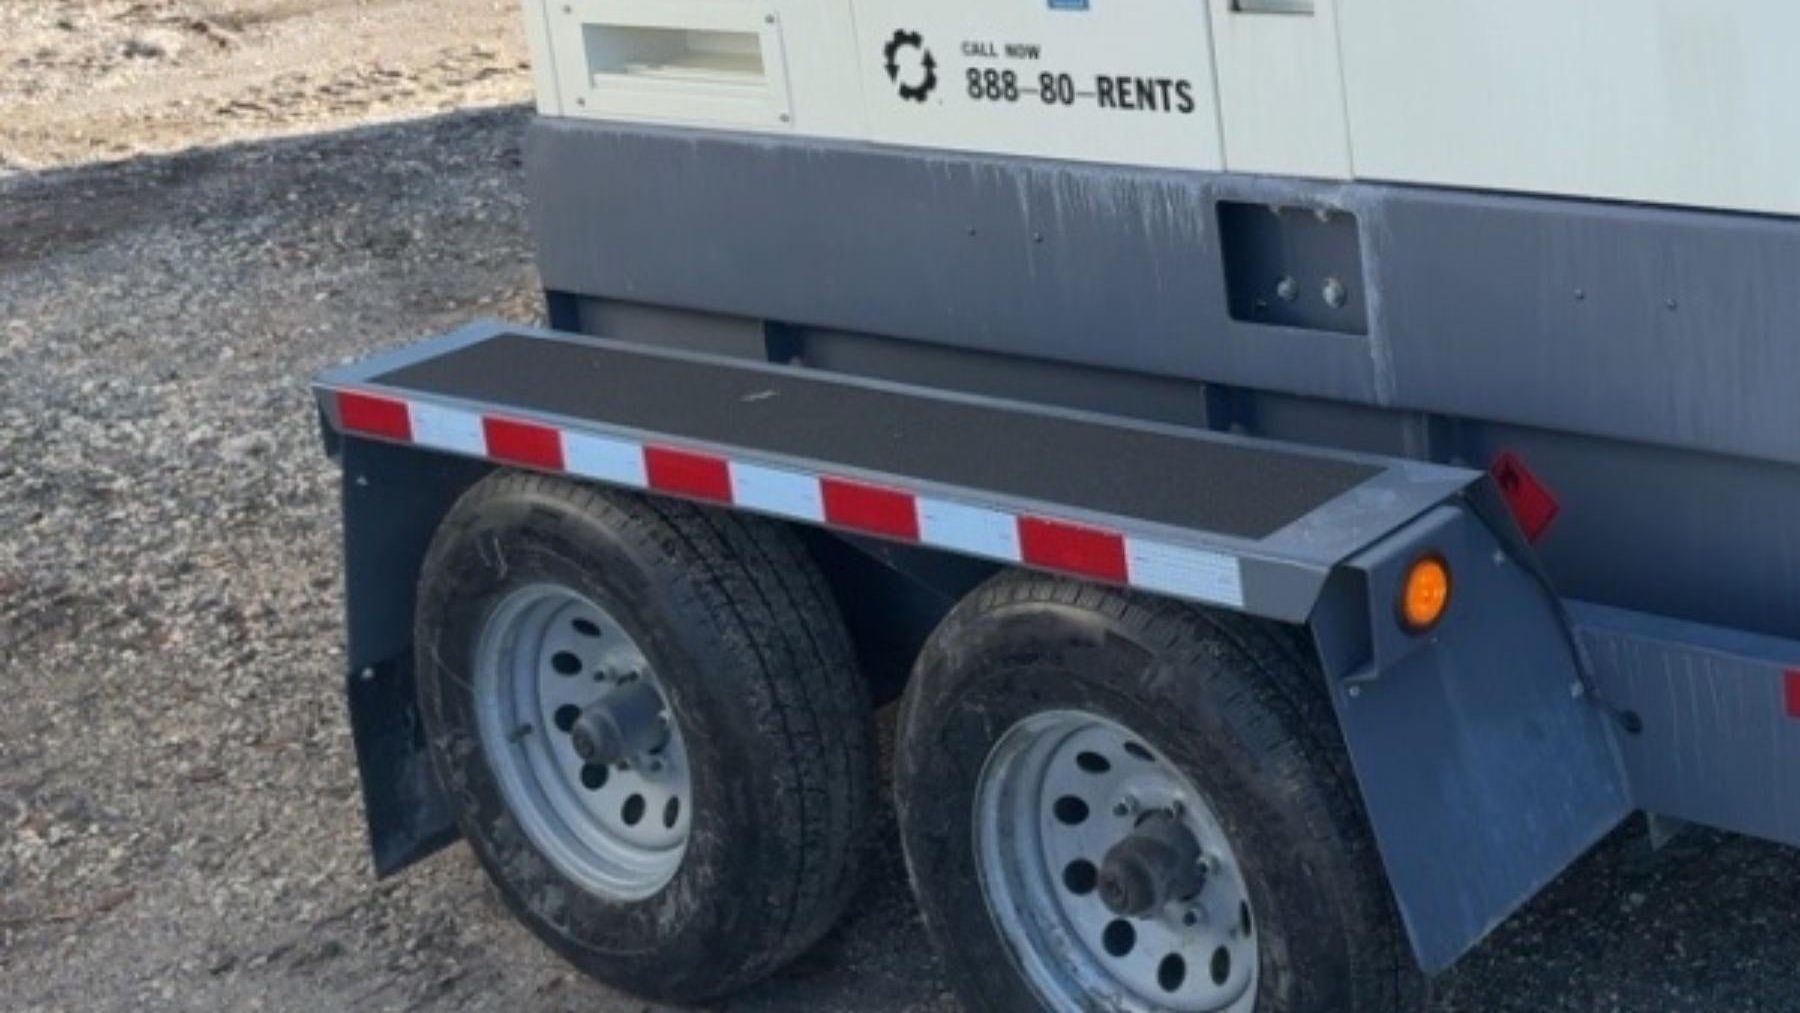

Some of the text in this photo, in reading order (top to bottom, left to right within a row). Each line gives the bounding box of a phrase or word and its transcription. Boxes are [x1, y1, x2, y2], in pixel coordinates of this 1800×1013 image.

[961, 41, 1040, 60] CALL NOW
[965, 67, 1196, 115] 888-80-RENTS
